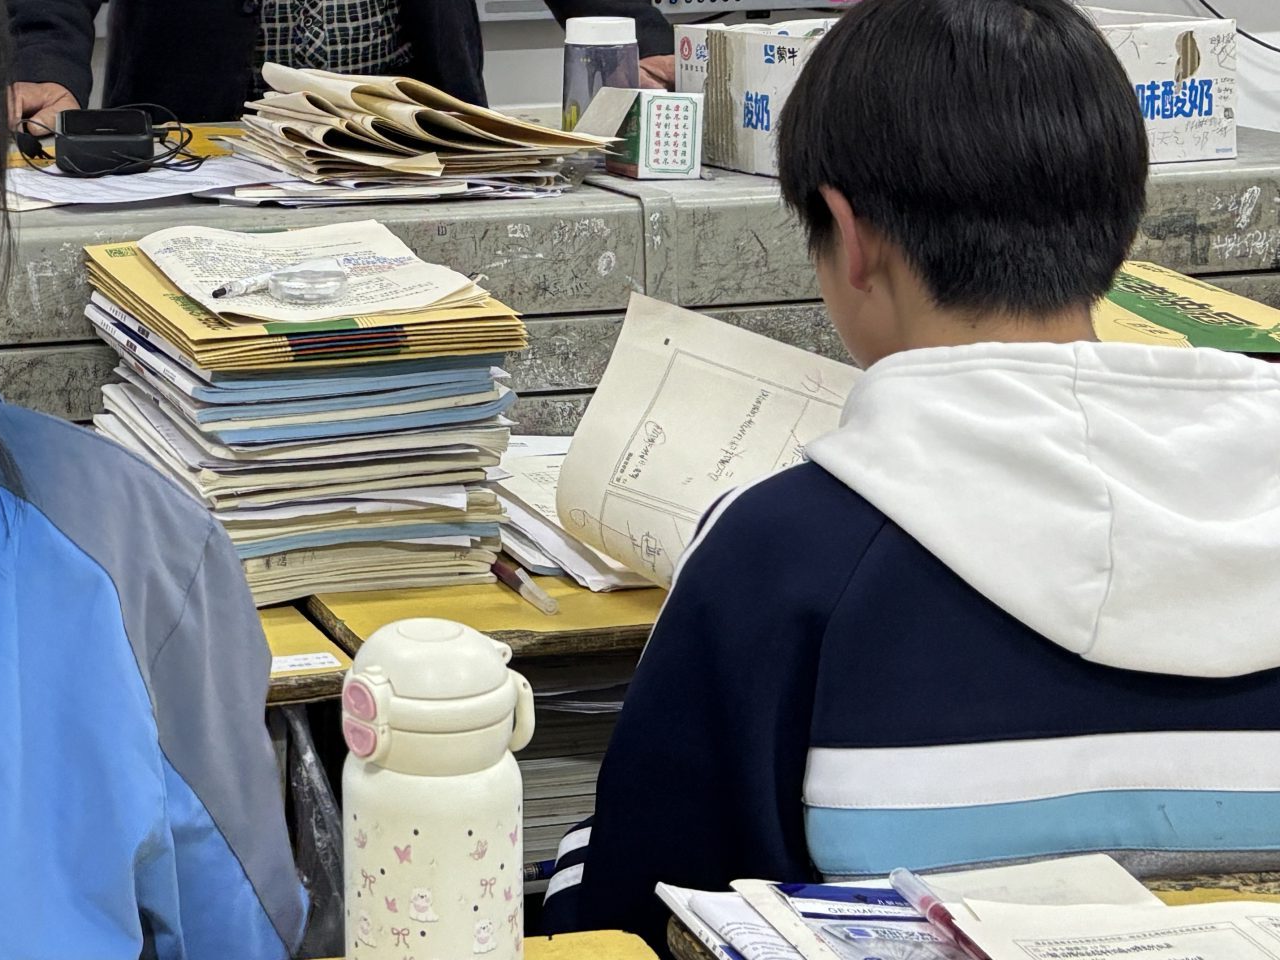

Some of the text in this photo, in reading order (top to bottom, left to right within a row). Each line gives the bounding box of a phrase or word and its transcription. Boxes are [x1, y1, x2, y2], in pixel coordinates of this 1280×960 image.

[776, 45, 799, 66] 蒙牛
[1135, 78, 1213, 120] 味酸奶
